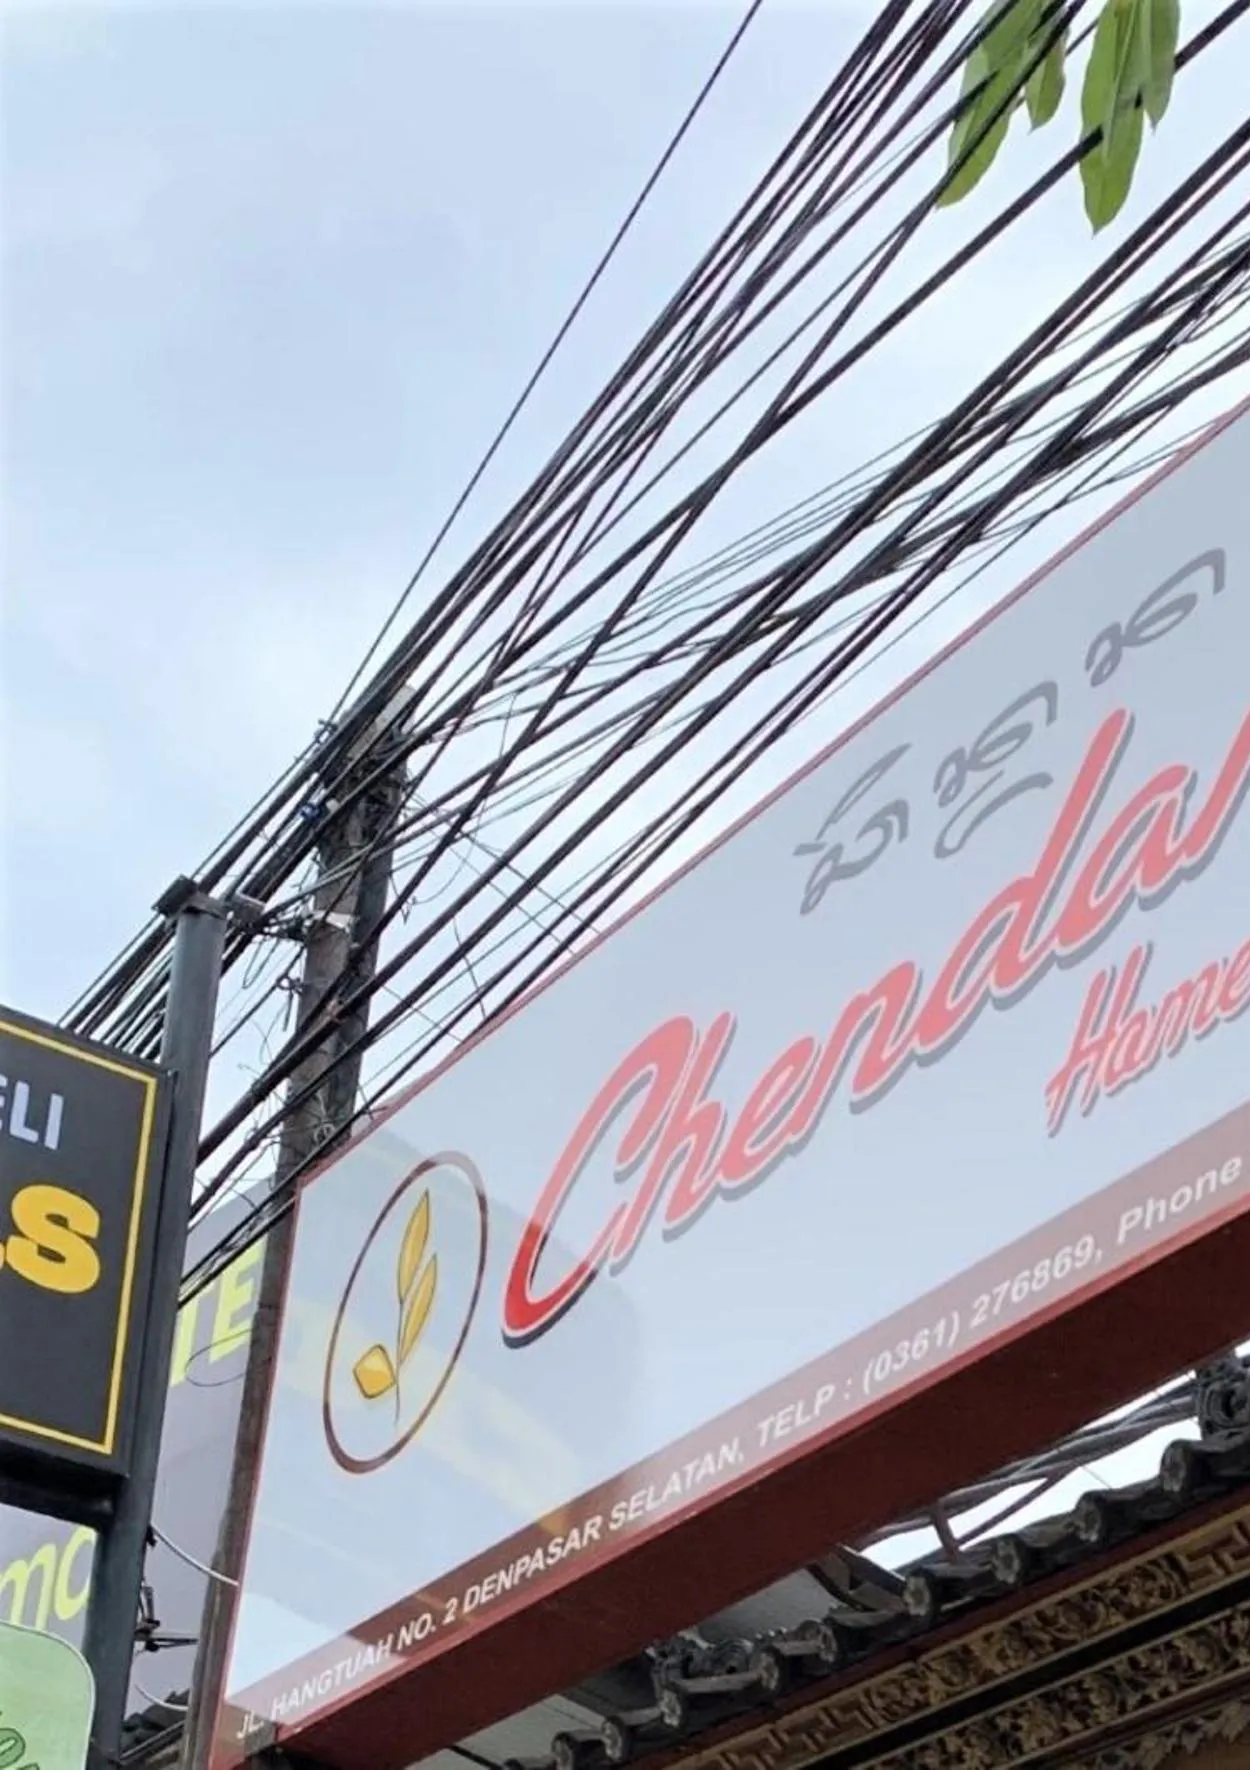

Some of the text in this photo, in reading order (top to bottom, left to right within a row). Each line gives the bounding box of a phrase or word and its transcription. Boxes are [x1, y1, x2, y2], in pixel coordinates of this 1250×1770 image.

[0, 1072, 64, 1151] LI
[0, 1184, 101, 1294] S
[270, 1636, 392, 1721] HANGTUAH
[397, 1612, 436, 1657] NO.
[443, 1598, 457, 1625] 2
[462, 1514, 603, 1614] DENPASAR
[609, 1439, 745, 1531] SELATAN,
[757, 1383, 835, 1447] TELP
[862, 1311, 962, 1396] (0361)
[970, 1233, 1103, 1330] 276869,
[1115, 1154, 1242, 1246] Phone
